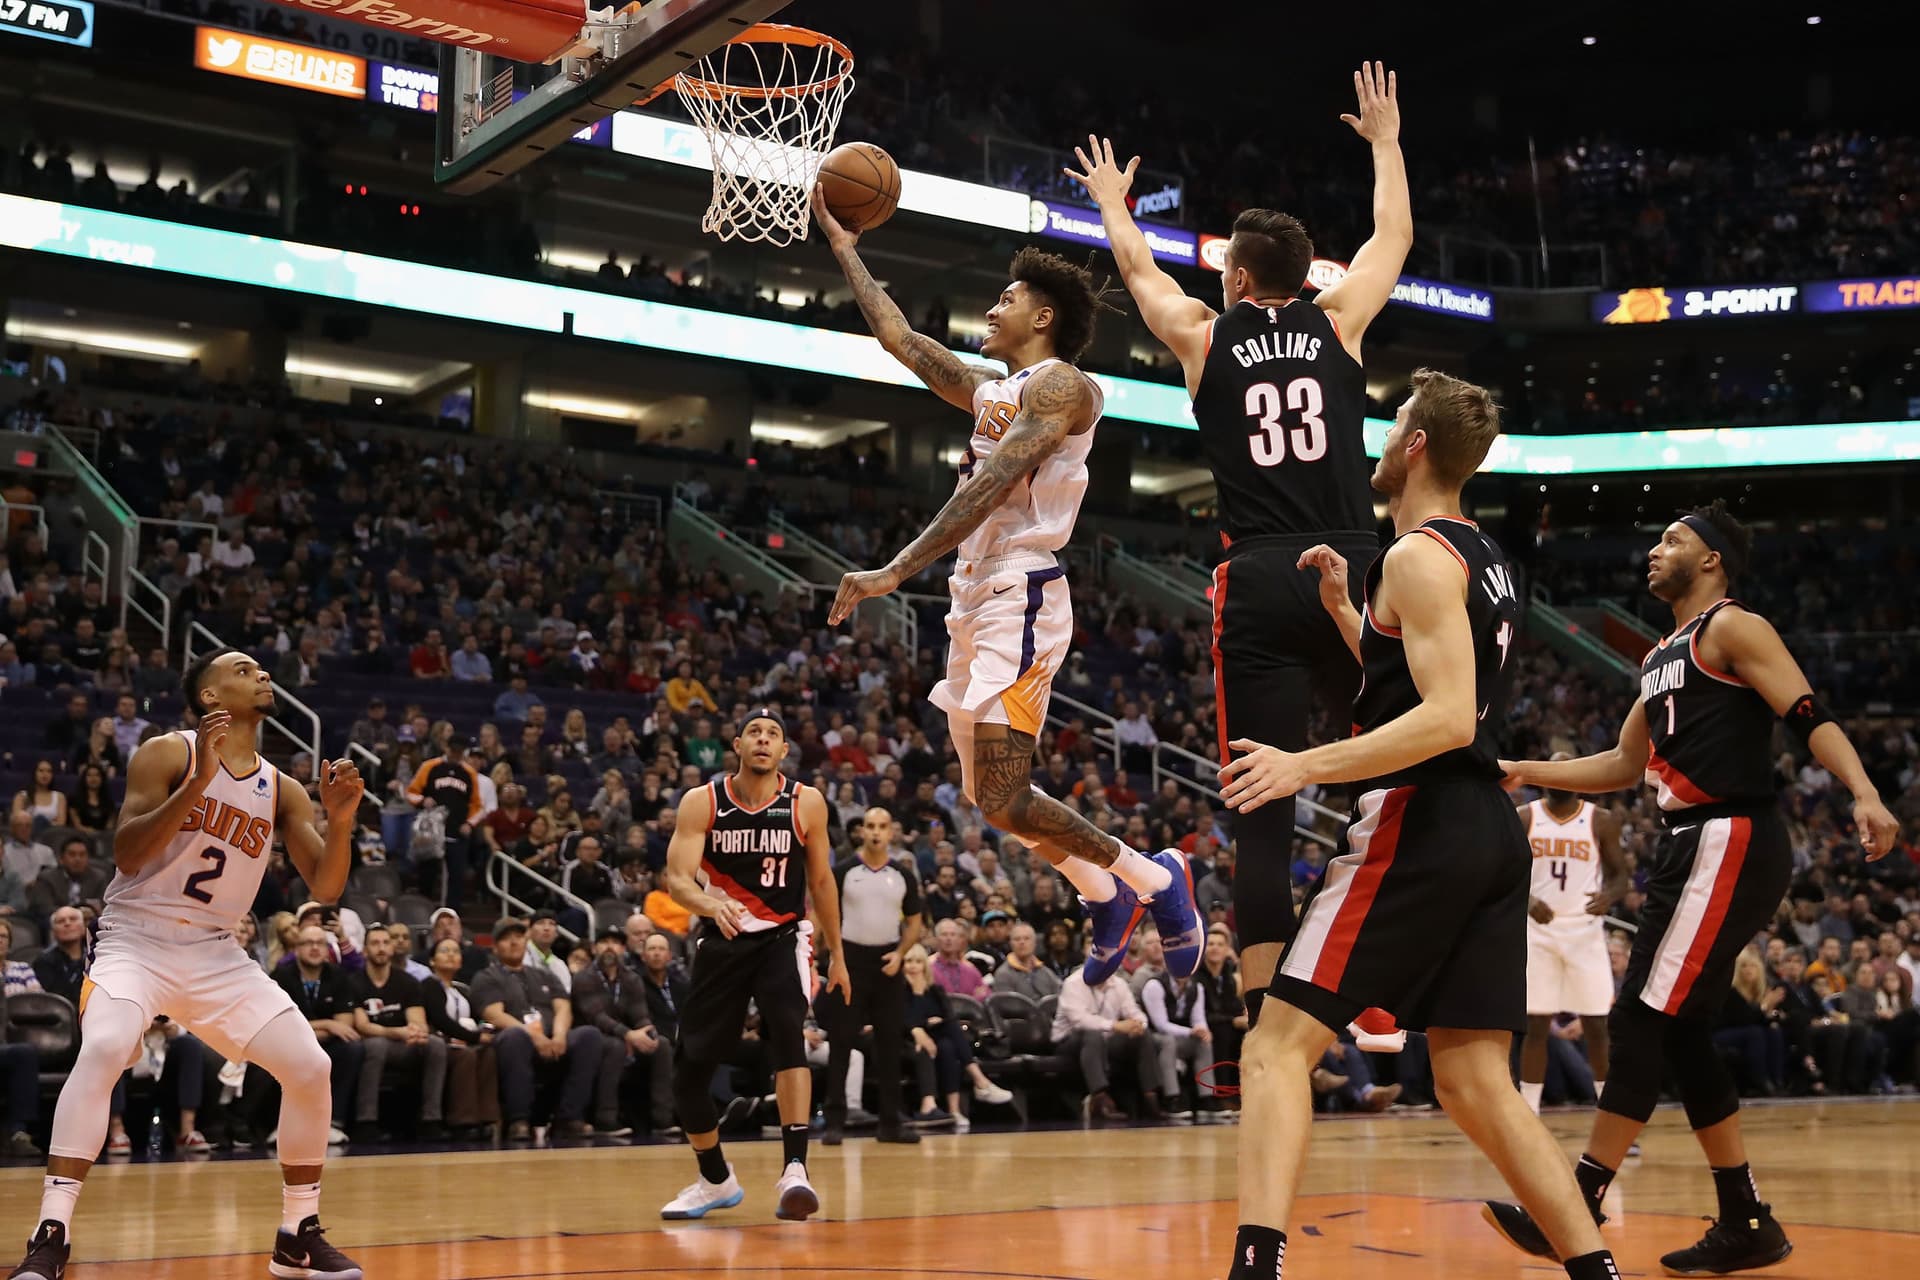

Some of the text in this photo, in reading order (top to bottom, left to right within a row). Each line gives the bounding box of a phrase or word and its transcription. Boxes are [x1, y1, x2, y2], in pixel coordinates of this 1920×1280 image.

[28, 4, 70, 31] FM
[336, 0, 493, 45] Farm
[246, 44, 356, 88] @SUNS
[381, 84, 419, 109] THE
[1049, 211, 1106, 239] TALKING
[1684, 286, 1797, 316] 3-POINT
[1231, 332, 1322, 368] COLLINS
[1245, 377, 1328, 467] 33
[1664, 695, 1676, 735] 1
[179, 794, 272, 859] SUNS
[711, 828, 792, 854] PORTLAND
[1531, 837, 1591, 862] SUNS
[182, 845, 227, 905] 2
[760, 856, 789, 887] 31
[1551, 860, 1567, 891] 4
